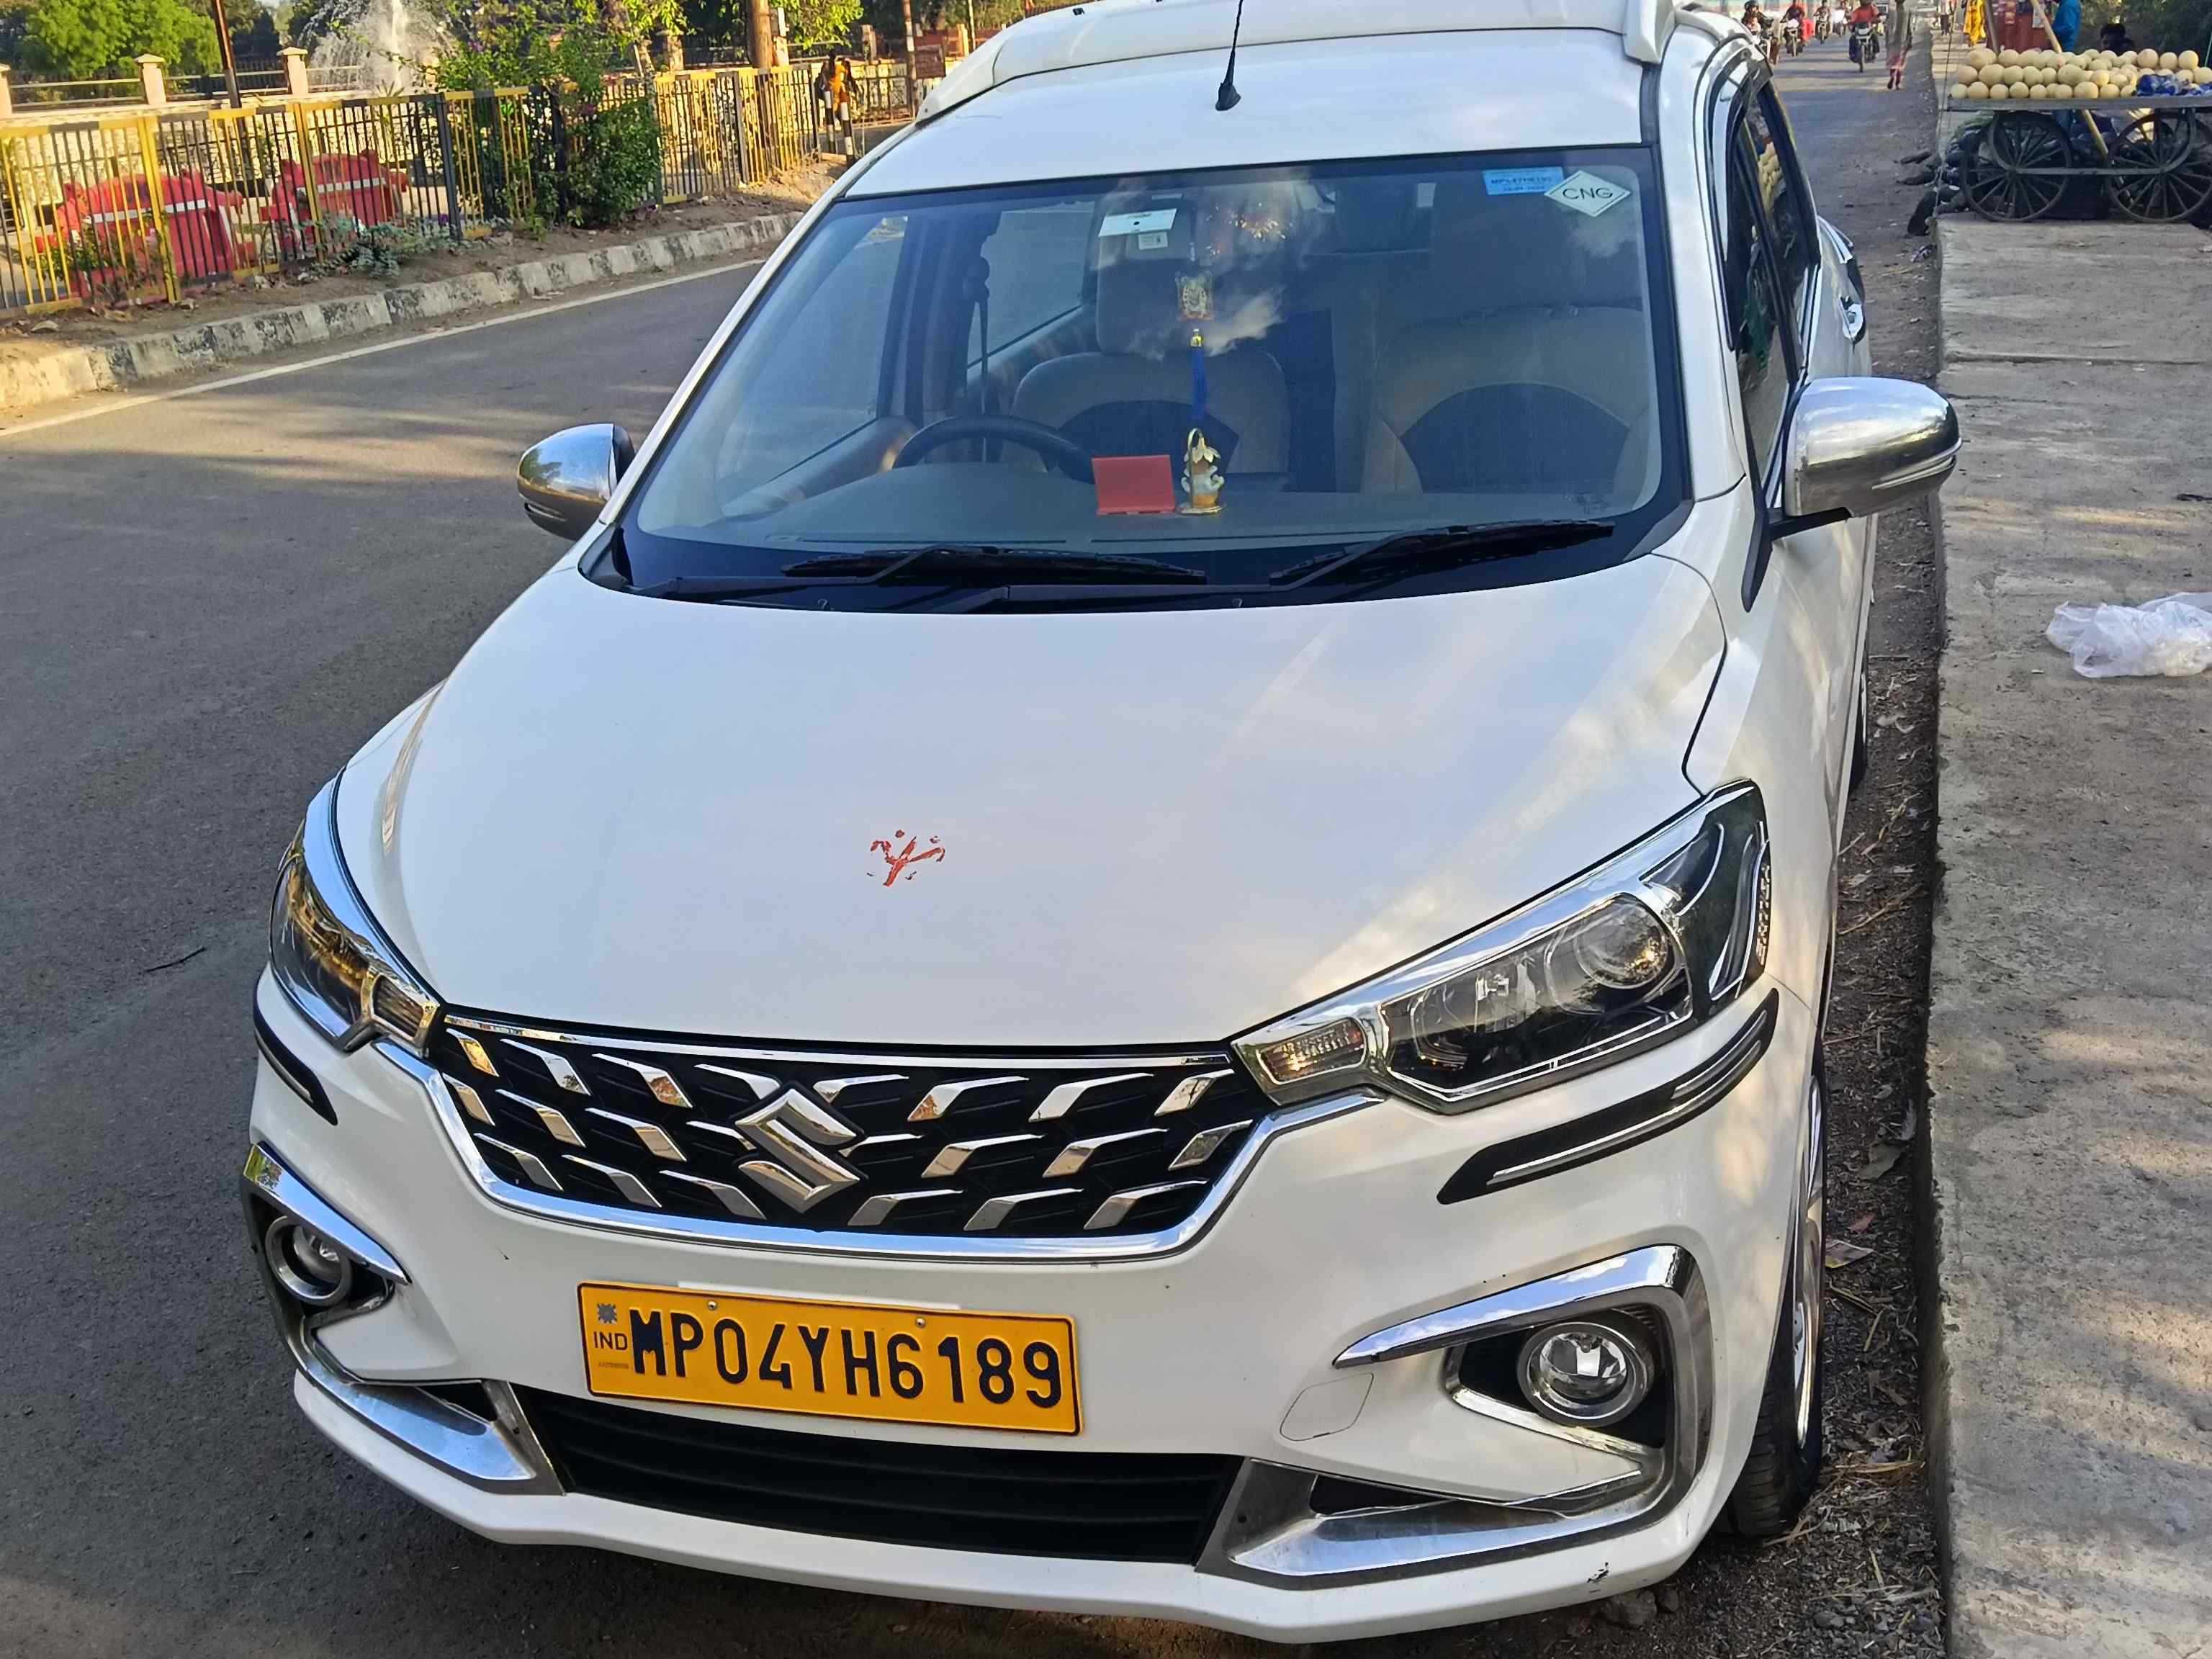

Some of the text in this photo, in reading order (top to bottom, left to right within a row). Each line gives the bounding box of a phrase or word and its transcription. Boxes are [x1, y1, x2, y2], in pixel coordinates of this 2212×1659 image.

[1562, 187, 1614, 200] CNG
[593, 1331, 628, 1351] IND
[629, 1309, 1061, 1408] MP04YH6189
